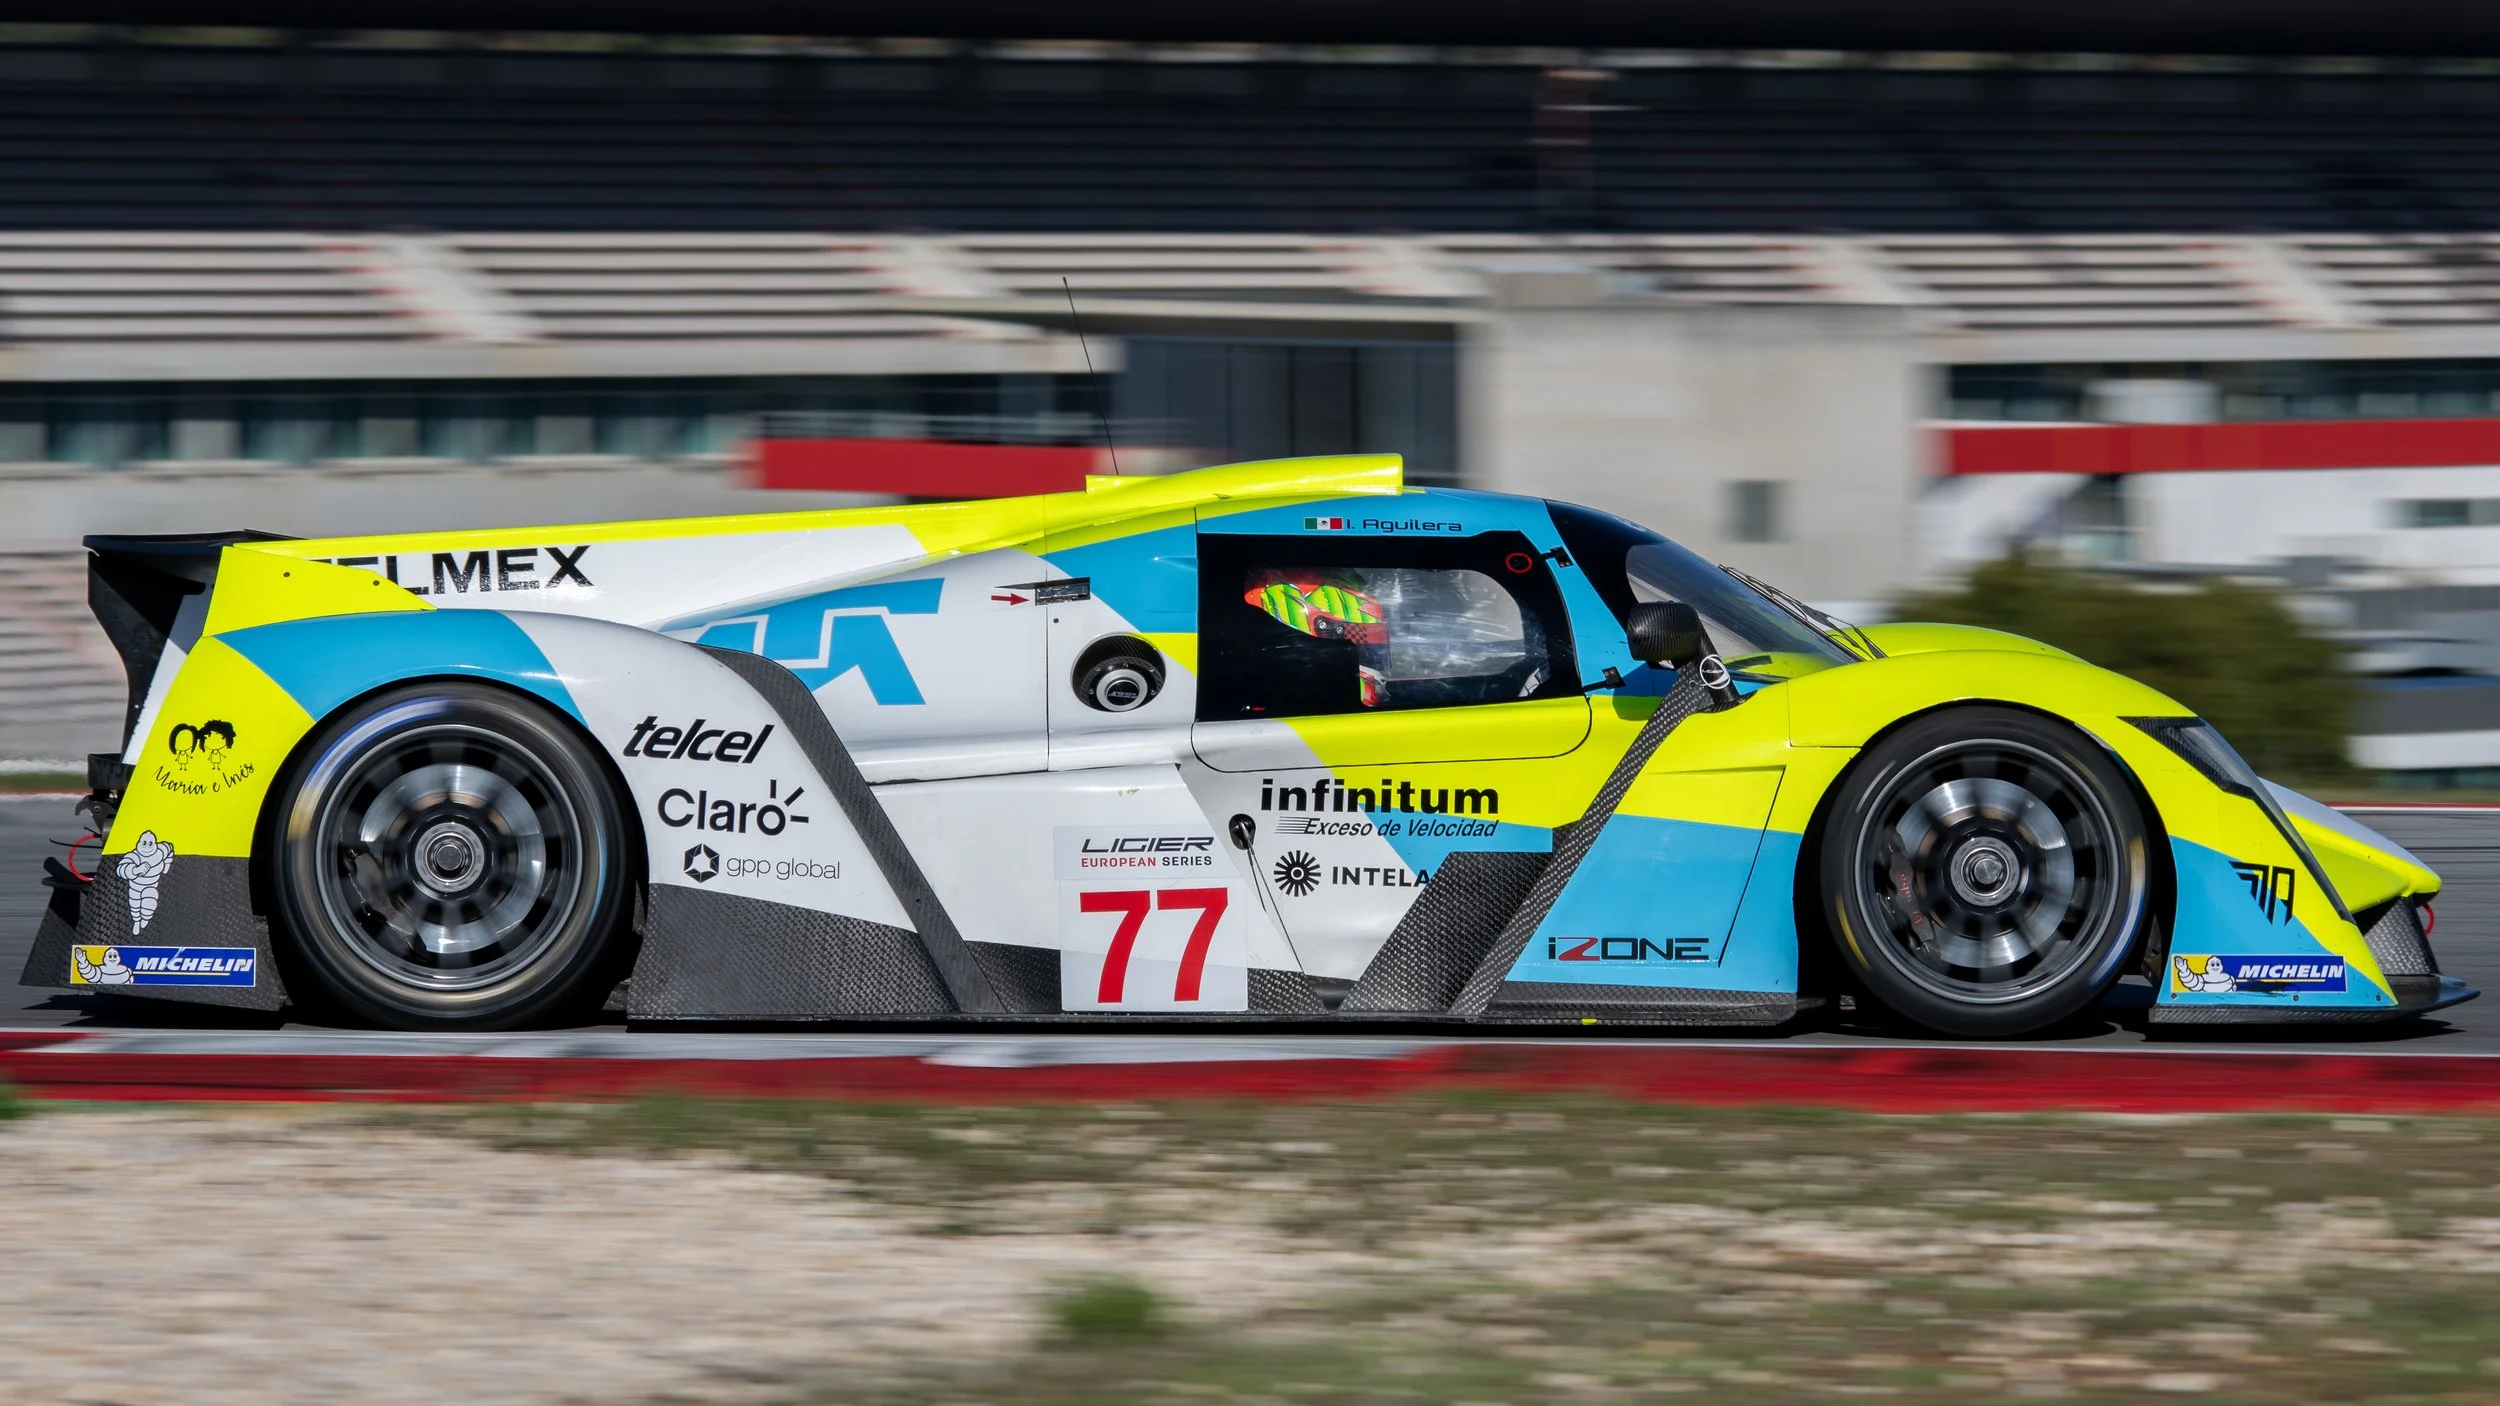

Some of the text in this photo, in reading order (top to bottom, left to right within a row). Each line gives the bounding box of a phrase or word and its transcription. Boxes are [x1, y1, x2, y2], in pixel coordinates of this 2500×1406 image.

[1363, 519, 1462, 533] Aguilera
[309, 545, 595, 595] LMEX
[622, 716, 775, 764] telcel
[212, 782, 221, 793] e
[1260, 778, 1499, 814] infinitum
[657, 787, 786, 836] Claro
[1304, 817, 1499, 837] Exceso de Velocidad
[1081, 836, 1215, 853] LIGIER
[726, 857, 840, 880] gpp global
[1081, 856, 1212, 868] EUROPEAN SERIES
[1080, 887, 1229, 1004] 77
[134, 957, 254, 972] MICHELIN
[2237, 964, 2344, 979] MICHELIN
